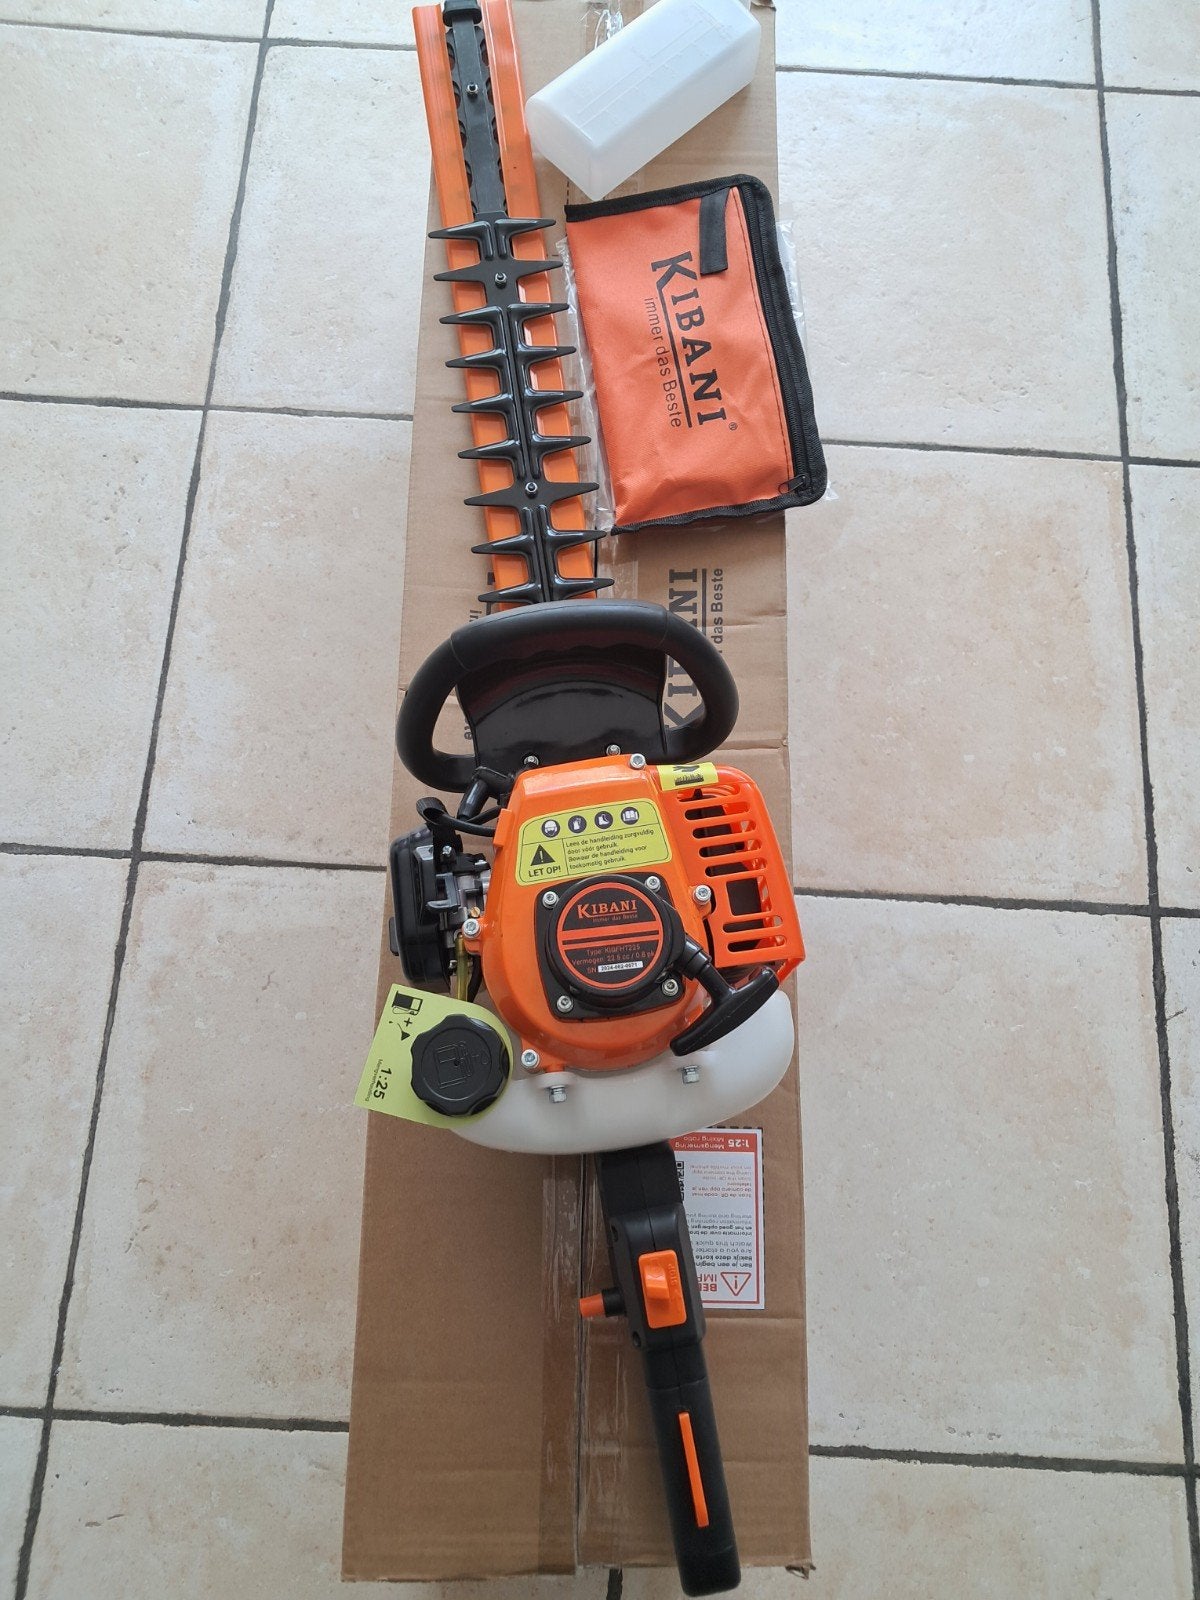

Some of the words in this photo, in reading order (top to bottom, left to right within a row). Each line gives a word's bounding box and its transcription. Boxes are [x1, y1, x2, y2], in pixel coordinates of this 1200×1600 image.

[651, 250, 727, 427] KIBANI
[644, 297, 663, 341] immer
[655, 346, 671, 377] das
[663, 379, 682, 428] Beste
[710, 568, 723, 612] Beste
[710, 616, 723, 643] das
[664, 568, 704, 728] KINI
[581, 838, 589, 846] de
[589, 833, 623, 845] handleiding
[624, 828, 655, 839] zorgvuldig
[591, 851, 599, 859] de
[600, 846, 634, 858] handleiding
[528, 868, 543, 878] LET
[546, 866, 561, 876] OP!
[569, 860, 603, 870] toekomstig
[577, 899, 638, 919] KIBANI
[373, 1068, 392, 1100] 1:25
[728, 1138, 749, 1147] 1:25
